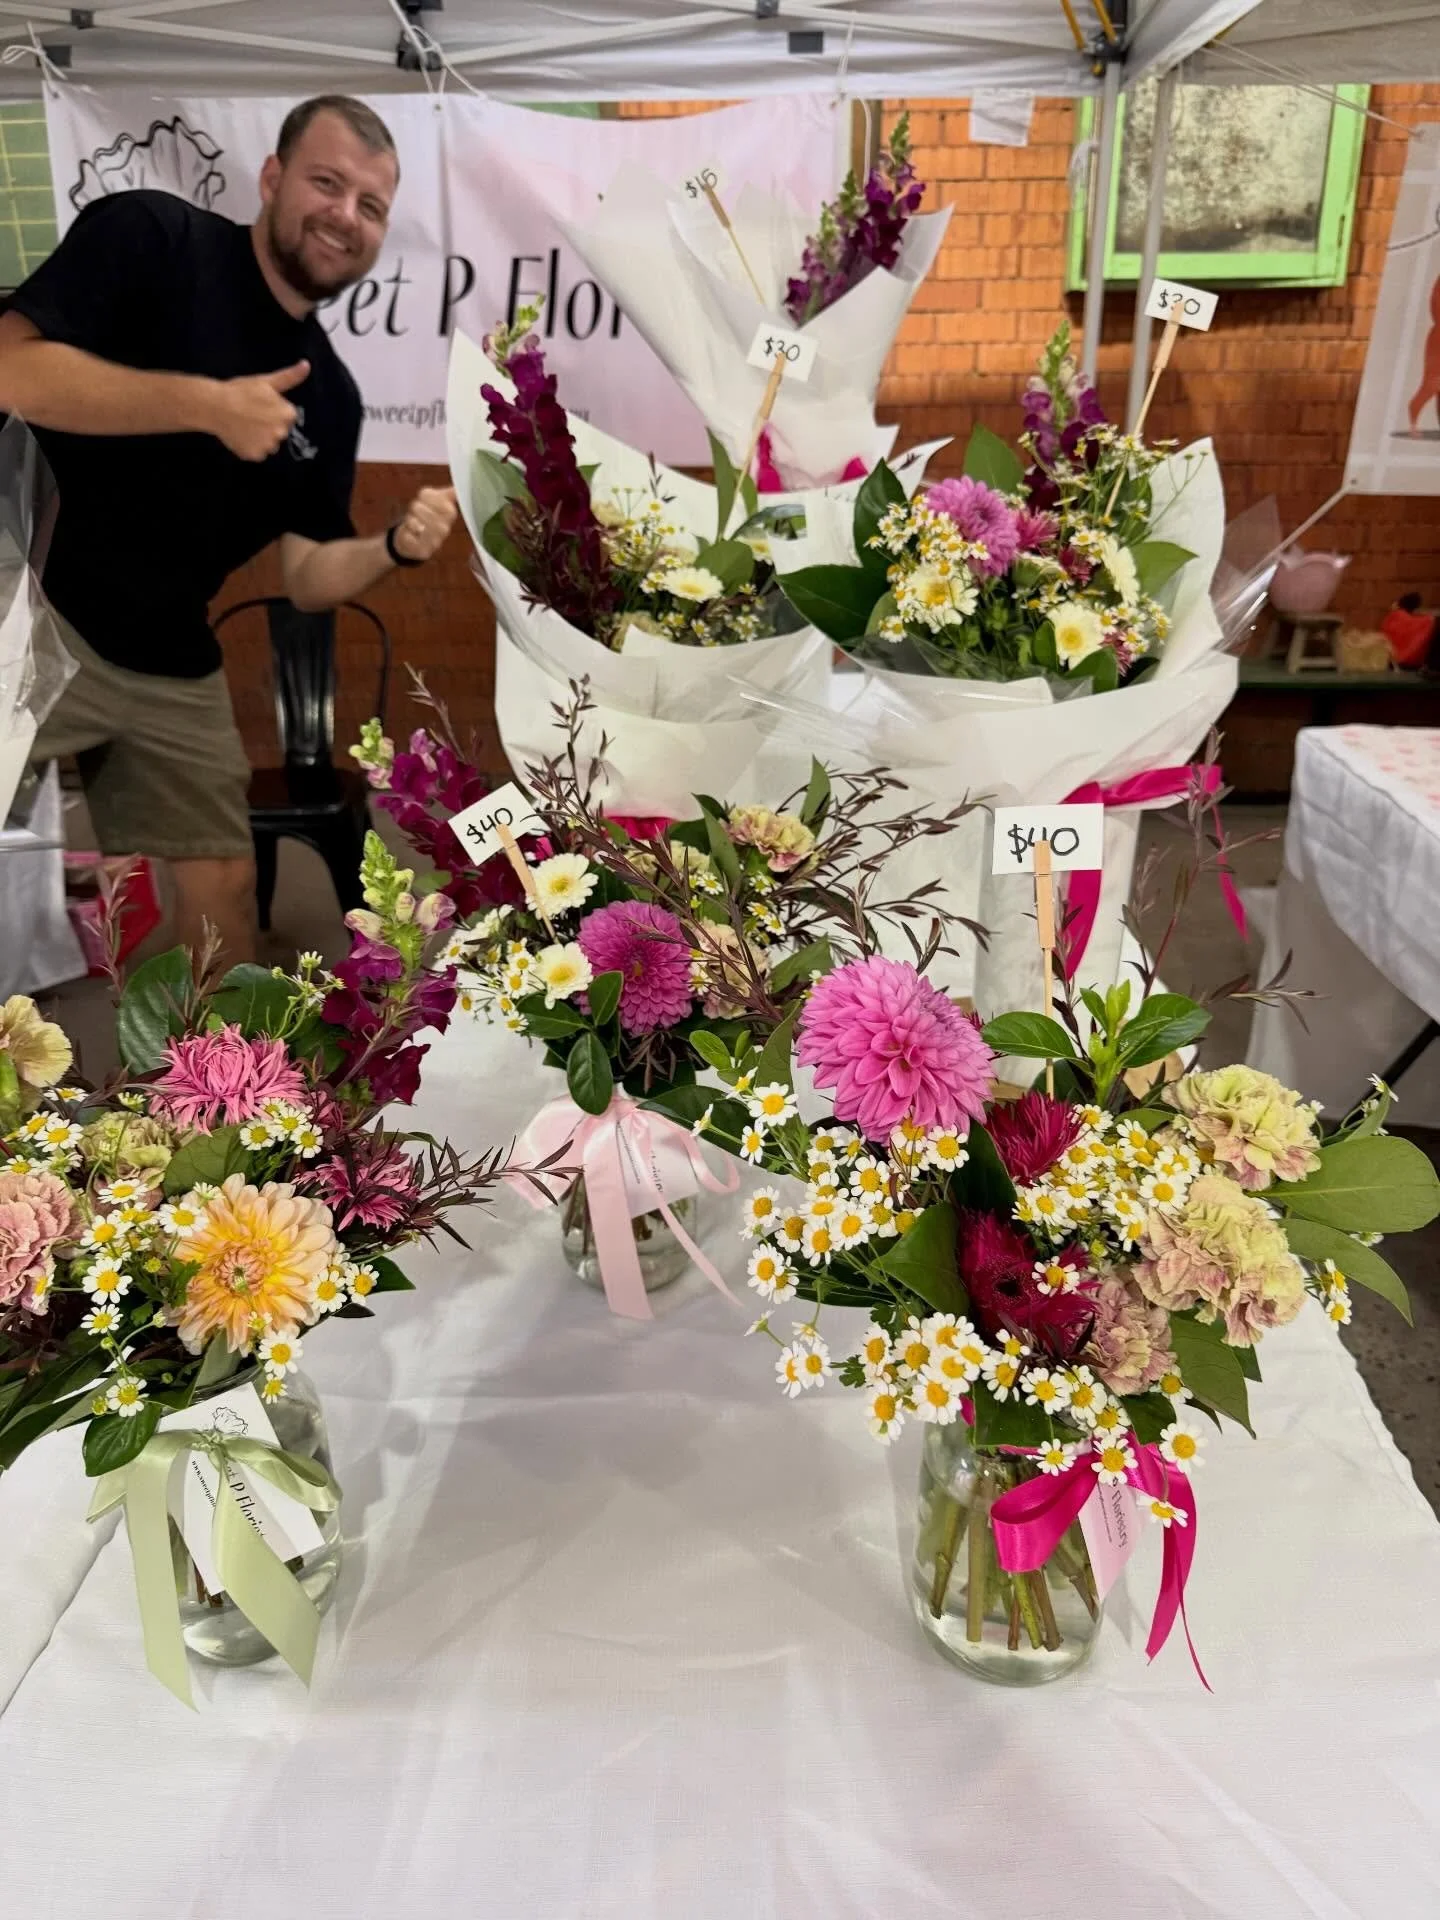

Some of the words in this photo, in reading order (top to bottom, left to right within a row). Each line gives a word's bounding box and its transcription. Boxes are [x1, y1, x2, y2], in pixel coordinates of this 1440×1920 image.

[438, 255, 476, 337] P
[466, 808, 513, 844] $40
[1007, 823, 1080, 863] $40
[229, 1482, 246, 1492] P
